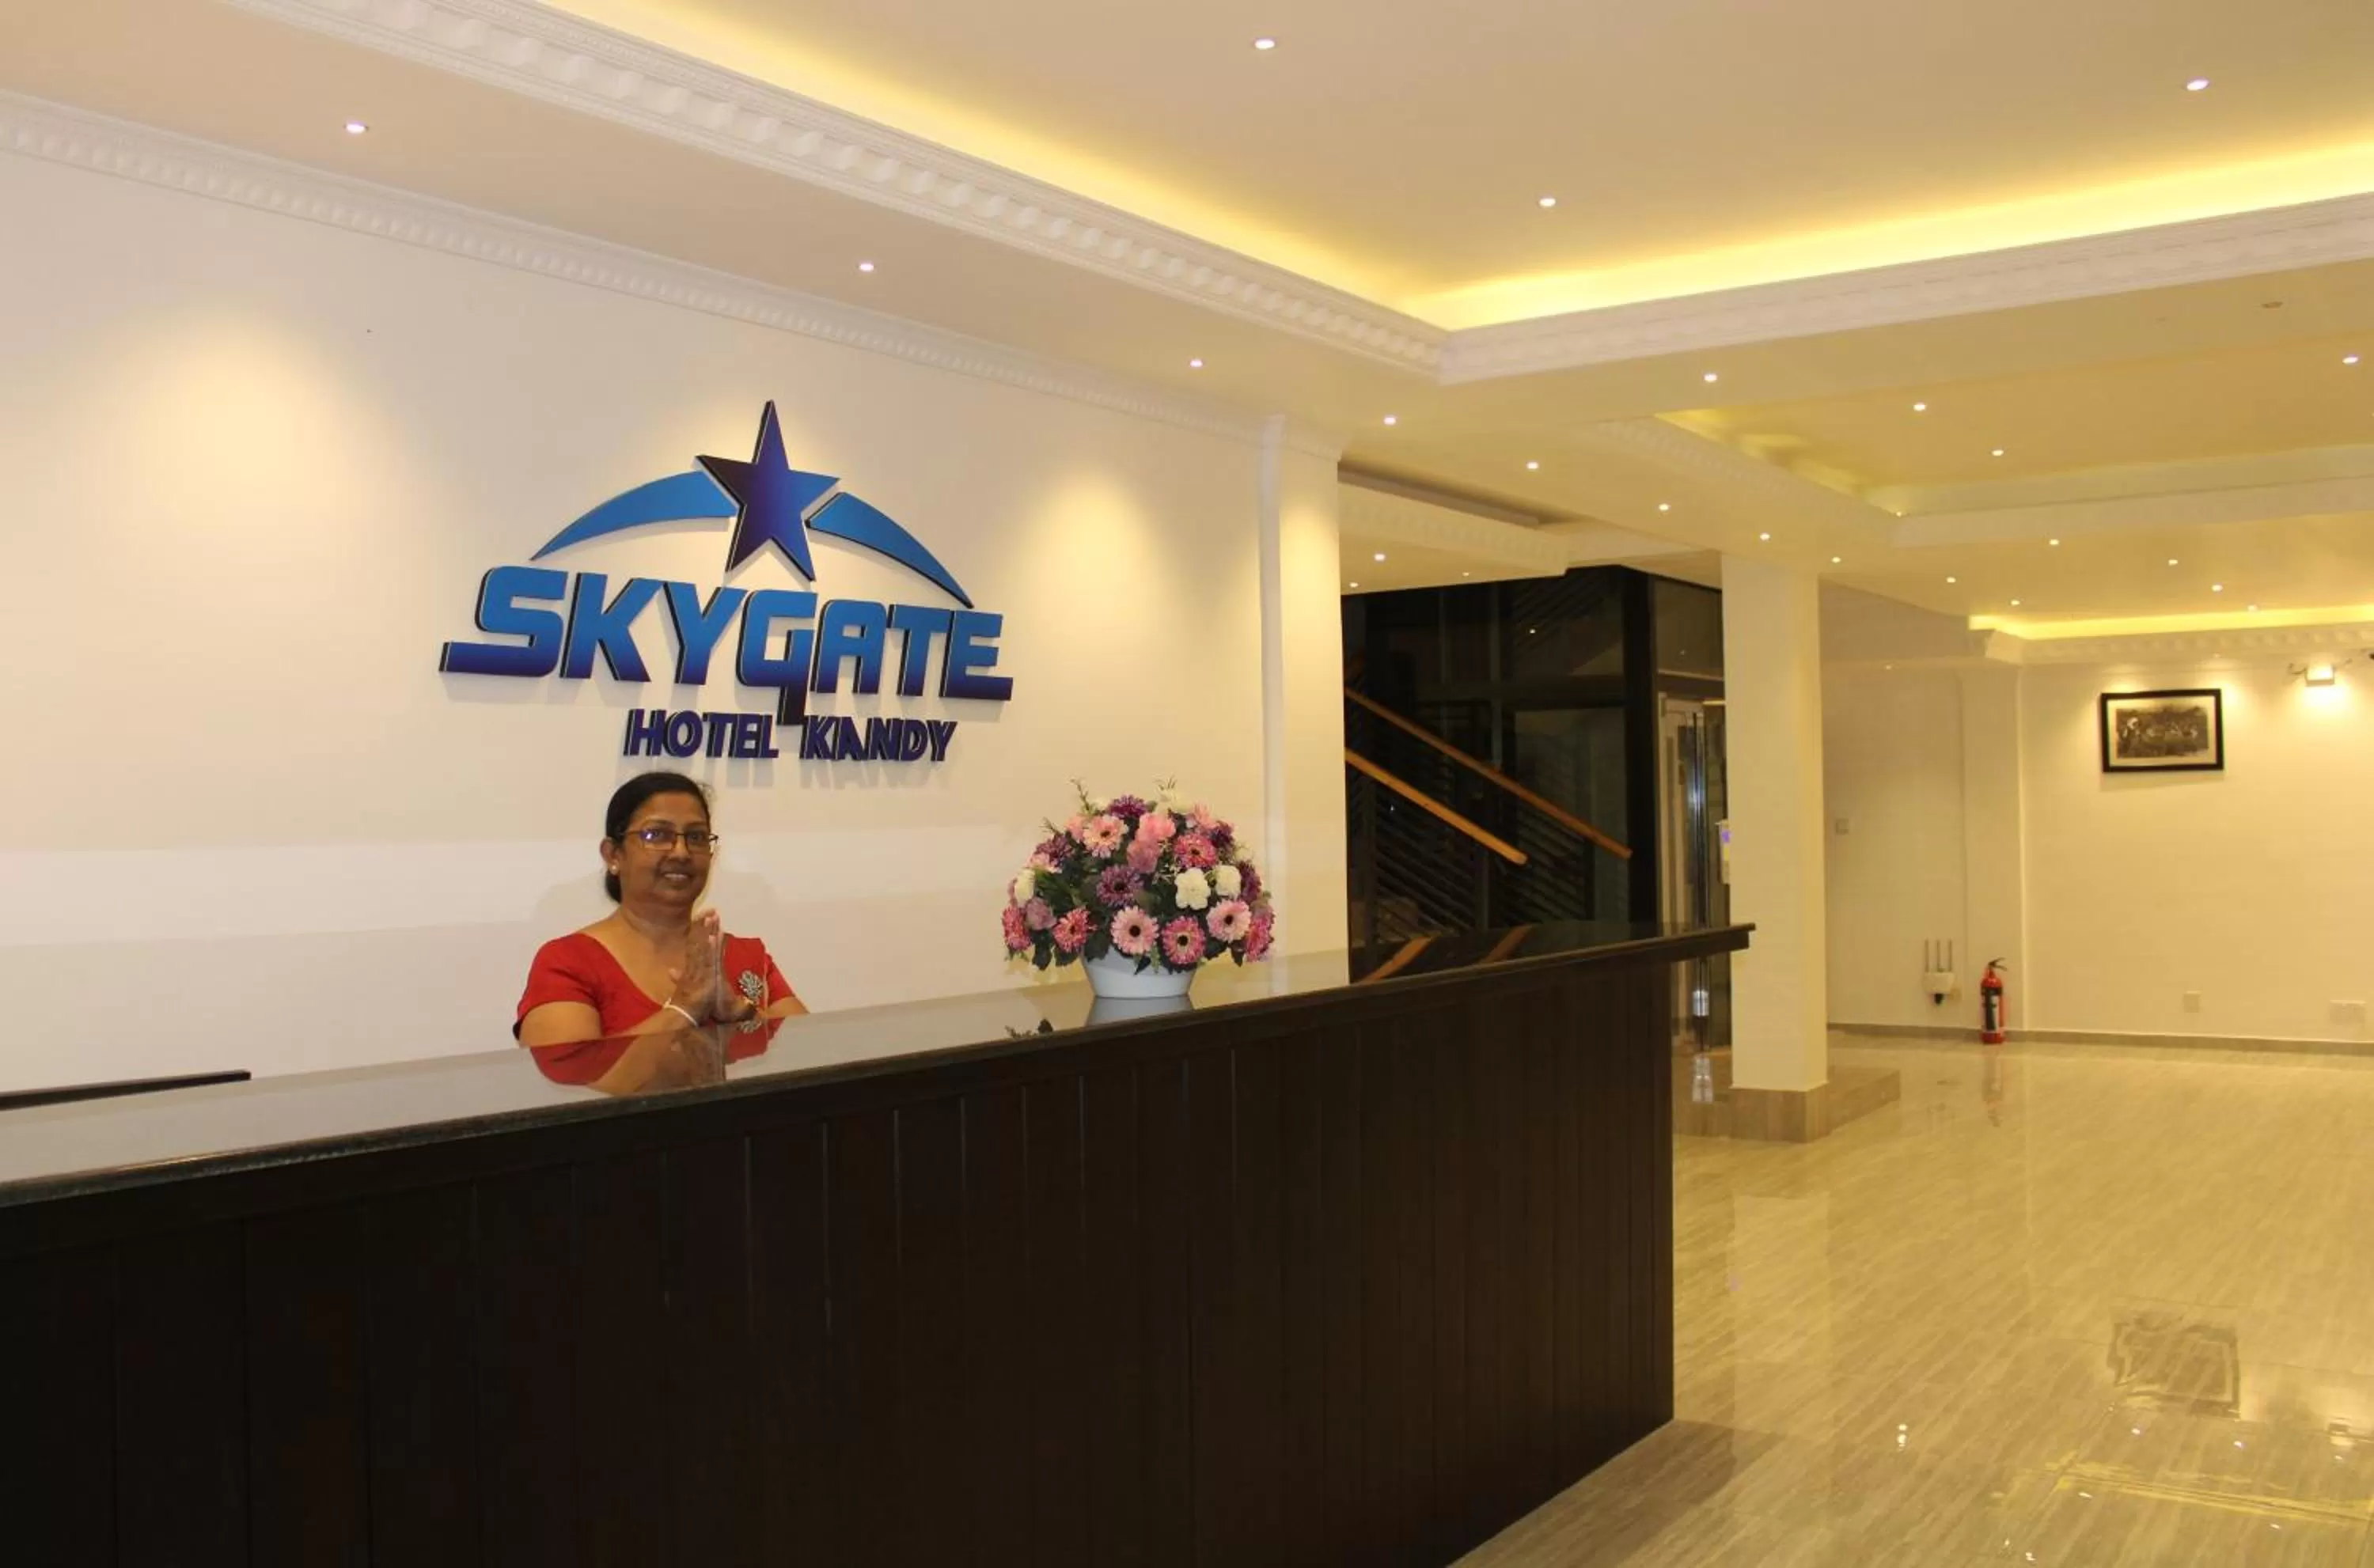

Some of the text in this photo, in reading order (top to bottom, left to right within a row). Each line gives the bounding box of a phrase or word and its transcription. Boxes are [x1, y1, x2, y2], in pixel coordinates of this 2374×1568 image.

[439, 565, 1014, 725] SKYGATE
[624, 707, 958, 762] HOTEL KANDY
